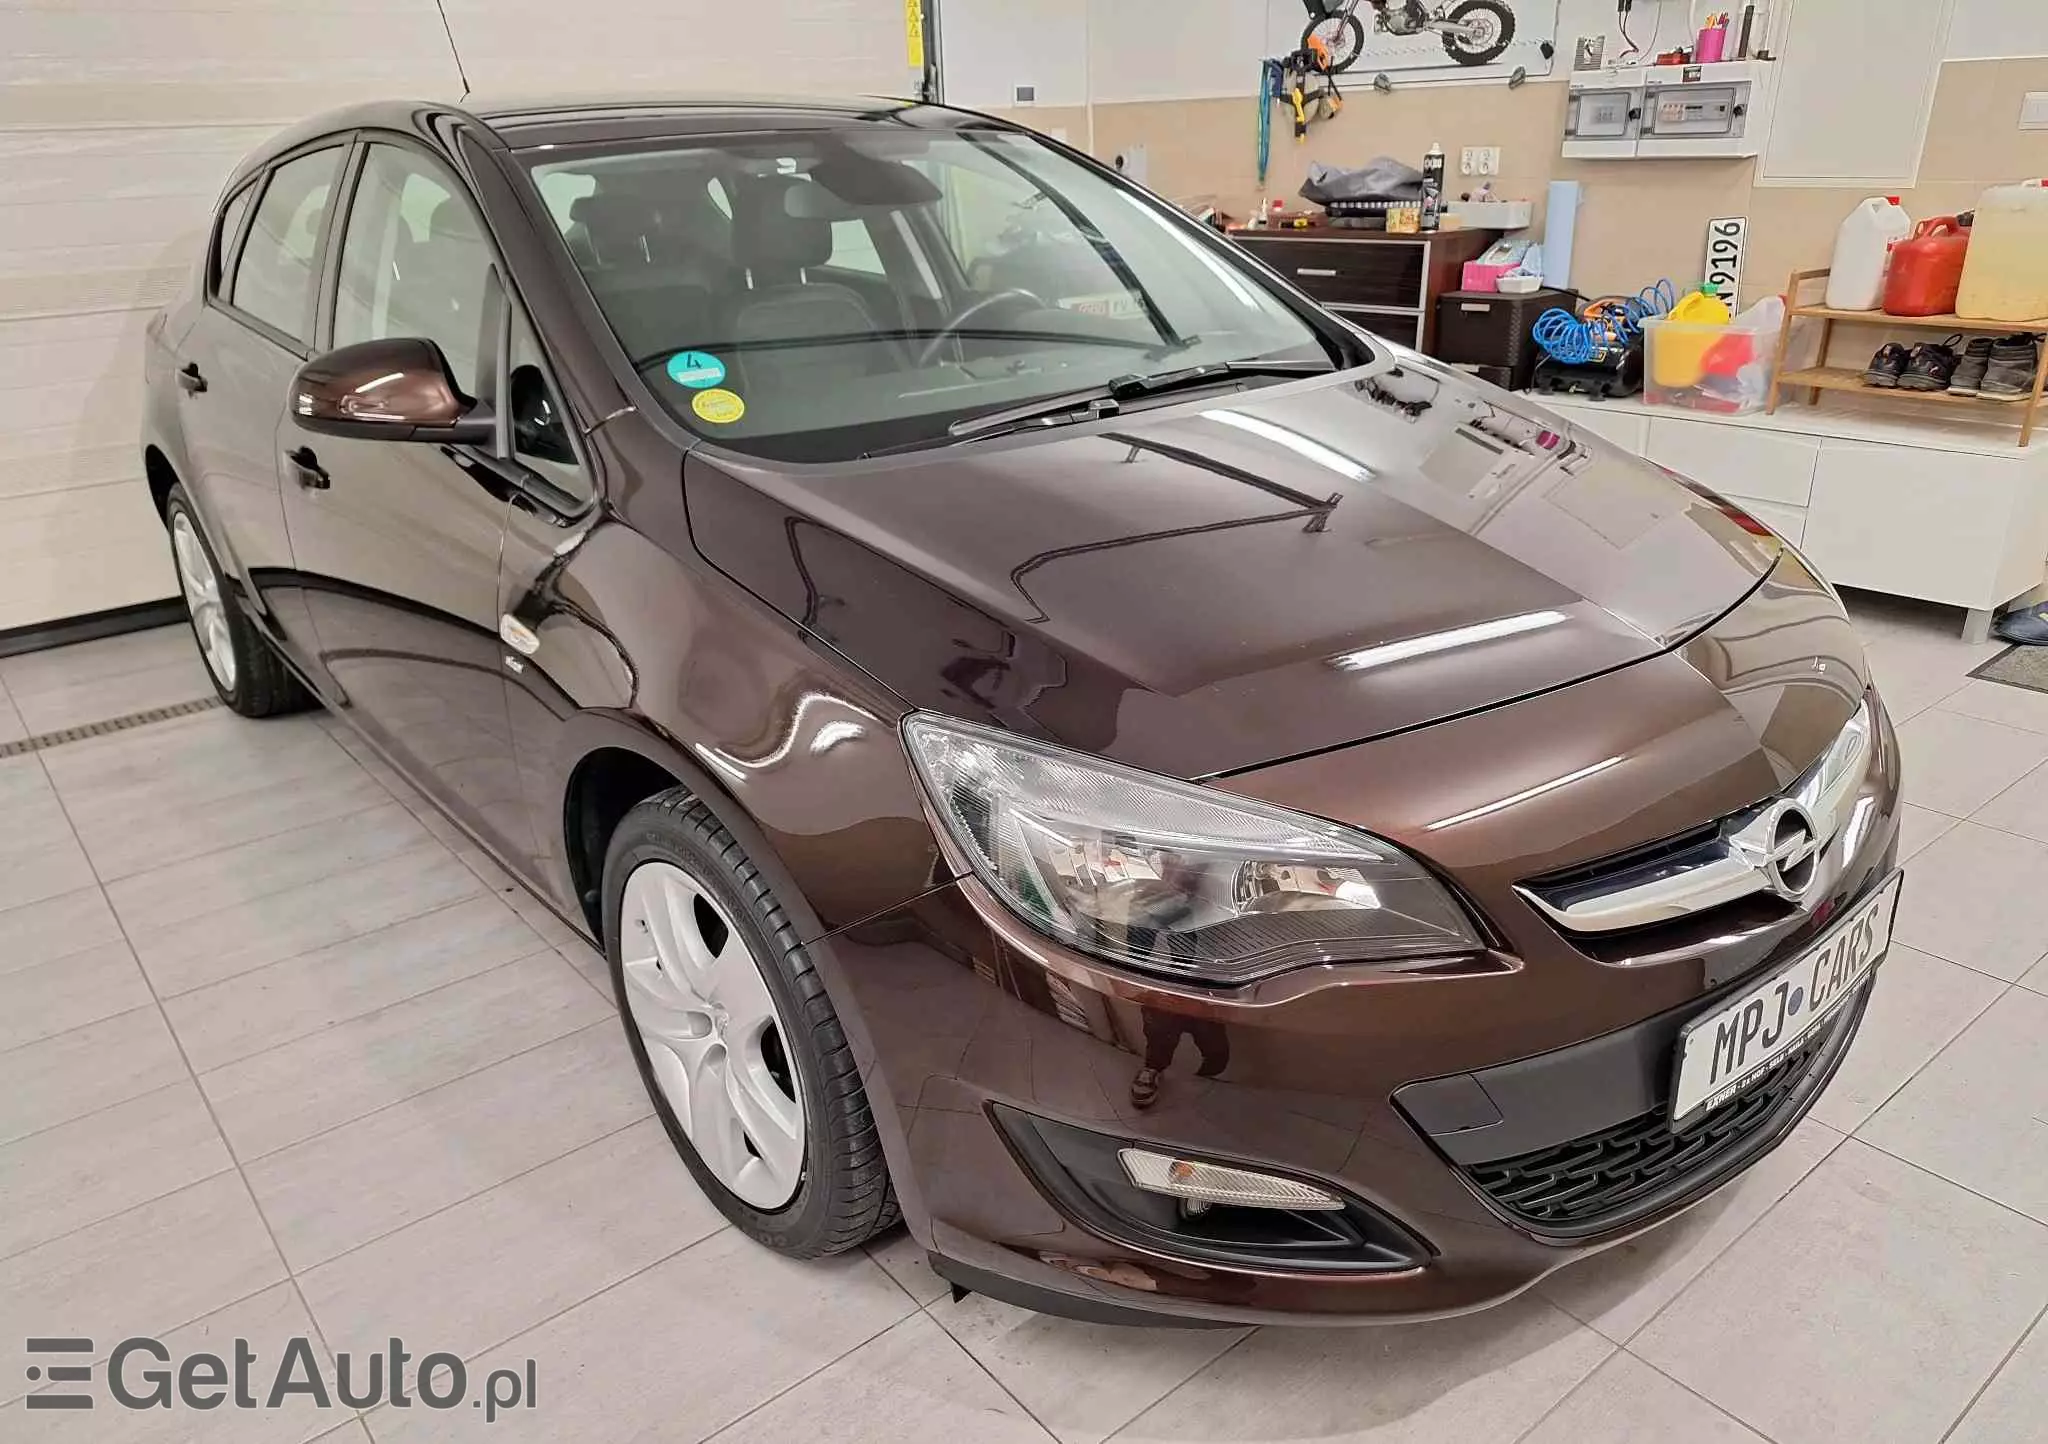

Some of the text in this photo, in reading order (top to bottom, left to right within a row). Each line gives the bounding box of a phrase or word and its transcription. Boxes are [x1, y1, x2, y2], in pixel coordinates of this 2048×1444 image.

[1709, 222, 1741, 285] 9196
[1709, 902, 1879, 1086] MPJ CARS
